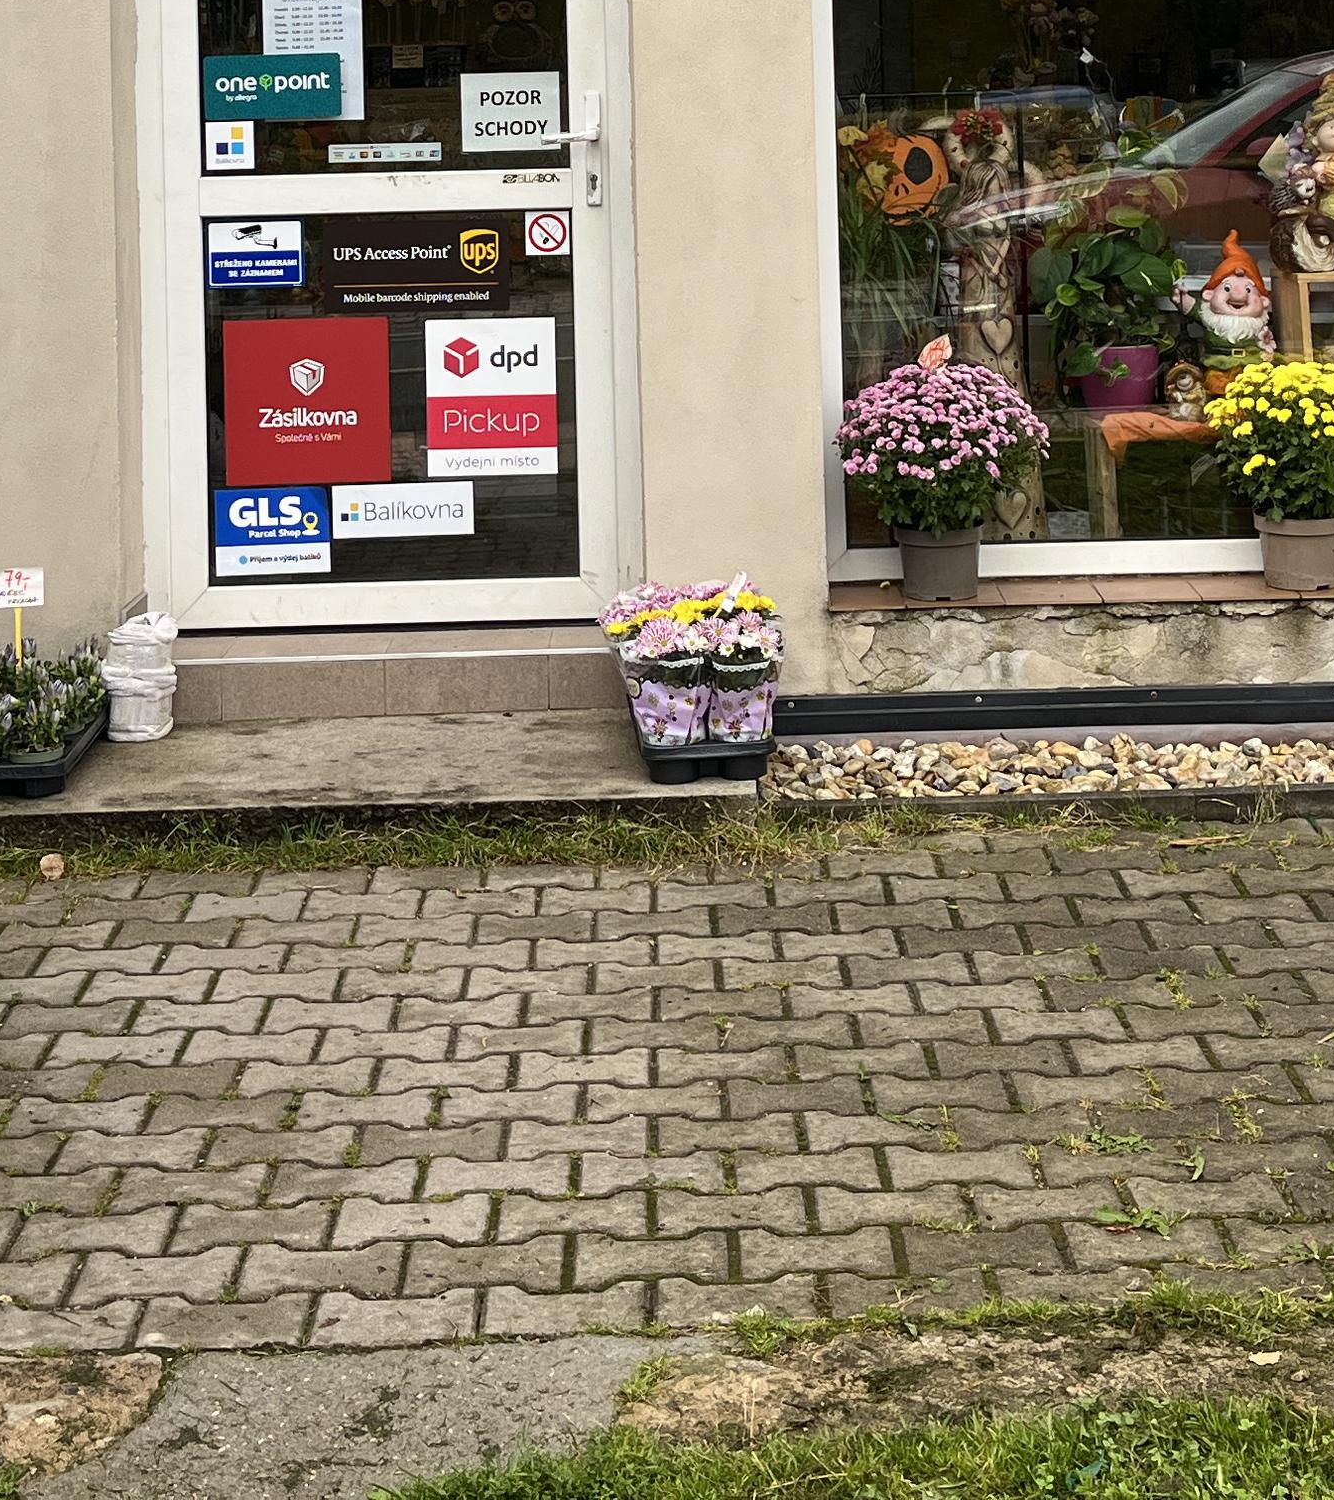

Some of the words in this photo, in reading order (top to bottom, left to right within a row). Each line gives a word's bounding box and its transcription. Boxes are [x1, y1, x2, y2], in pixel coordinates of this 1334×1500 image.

[215, 76, 258, 92] one
[274, 72, 331, 93] point
[479, 89, 542, 107] POZOR
[474, 119, 549, 137] SCHODY
[333, 247, 362, 261] UPS
[364, 247, 409, 260] Access
[464, 242, 495, 267] ups
[343, 293, 375, 303] Mobile
[376, 292, 412, 302] barcode
[413, 291, 453, 304] shipping
[453, 290, 490, 301] enabled
[490, 344, 538, 373] dpd
[258, 407, 358, 428] Zásilkovna
[443, 408, 540, 437] Pickup
[500, 455, 540, 467] místo
[229, 496, 302, 527] GLS
[364, 501, 464, 522] Balíkovna
[248, 529, 277, 539] Parcel
[278, 527, 301, 539] Shop
